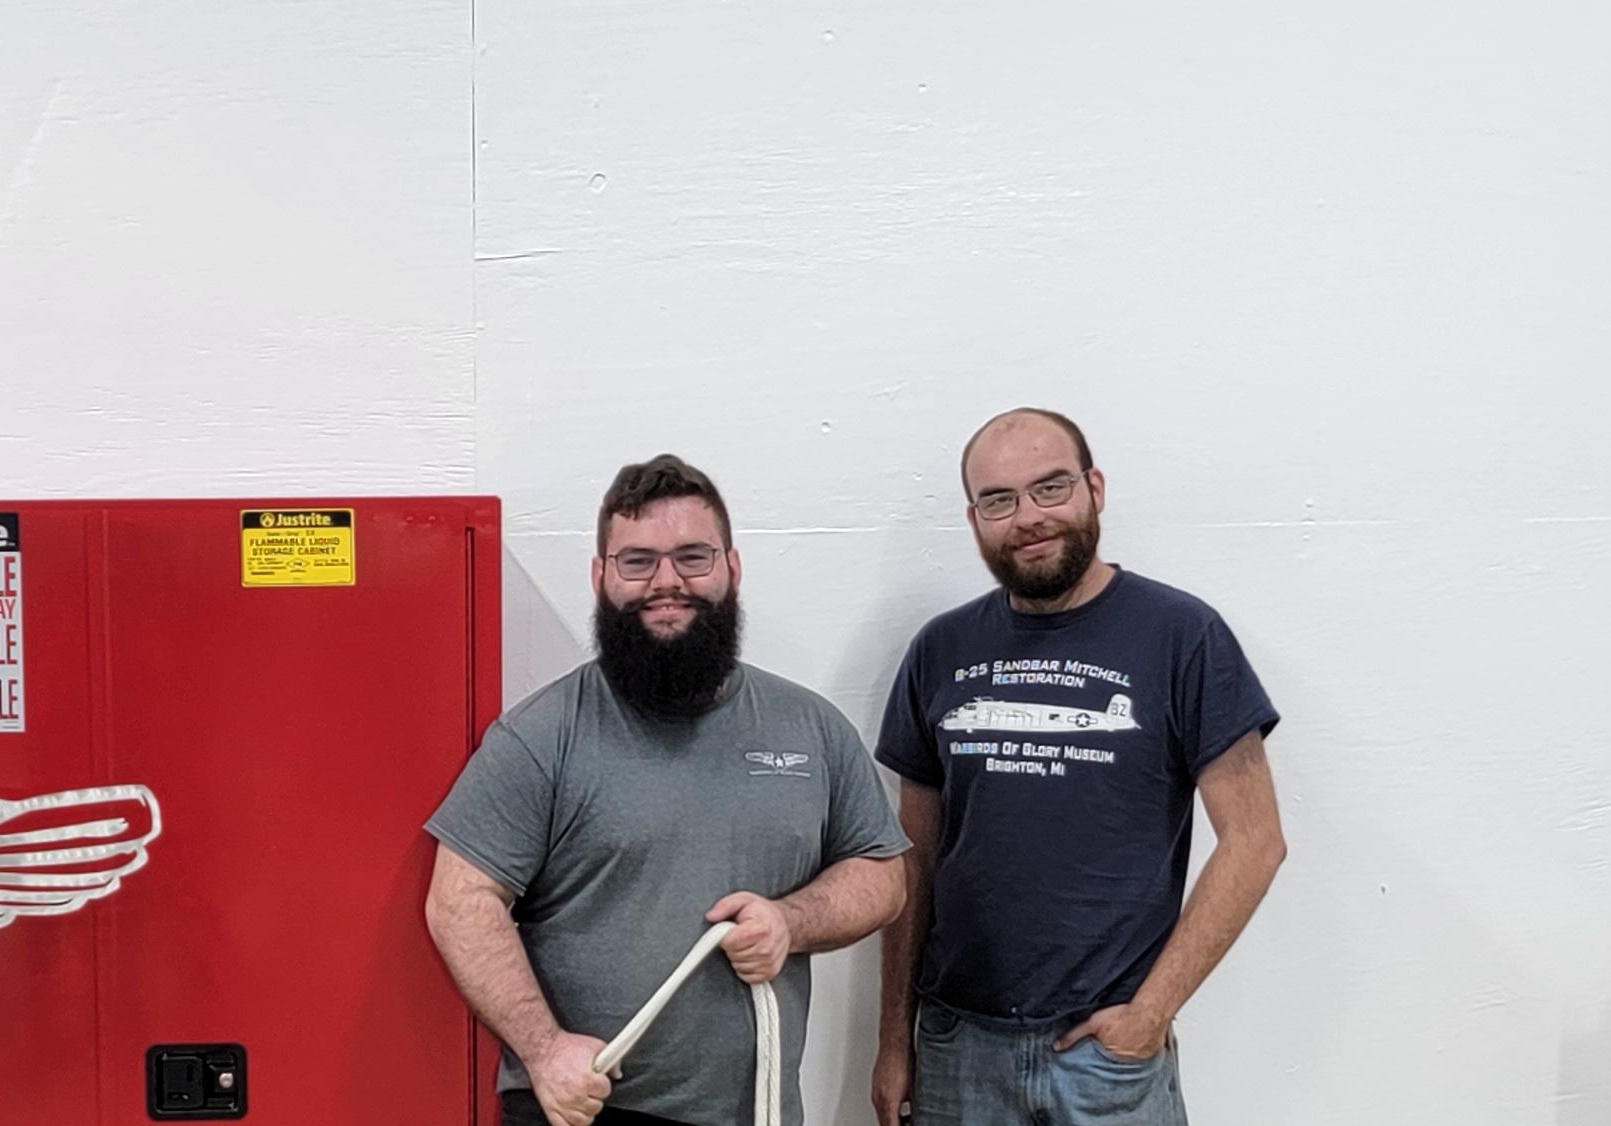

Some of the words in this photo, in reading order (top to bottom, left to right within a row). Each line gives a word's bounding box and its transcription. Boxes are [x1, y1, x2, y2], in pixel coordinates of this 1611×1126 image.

[276, 512, 331, 526] Justrite
[250, 537, 306, 547] FLAMMABLE
[955, 663, 988, 682] B-25
[992, 673, 1086, 688] RESTORATION
